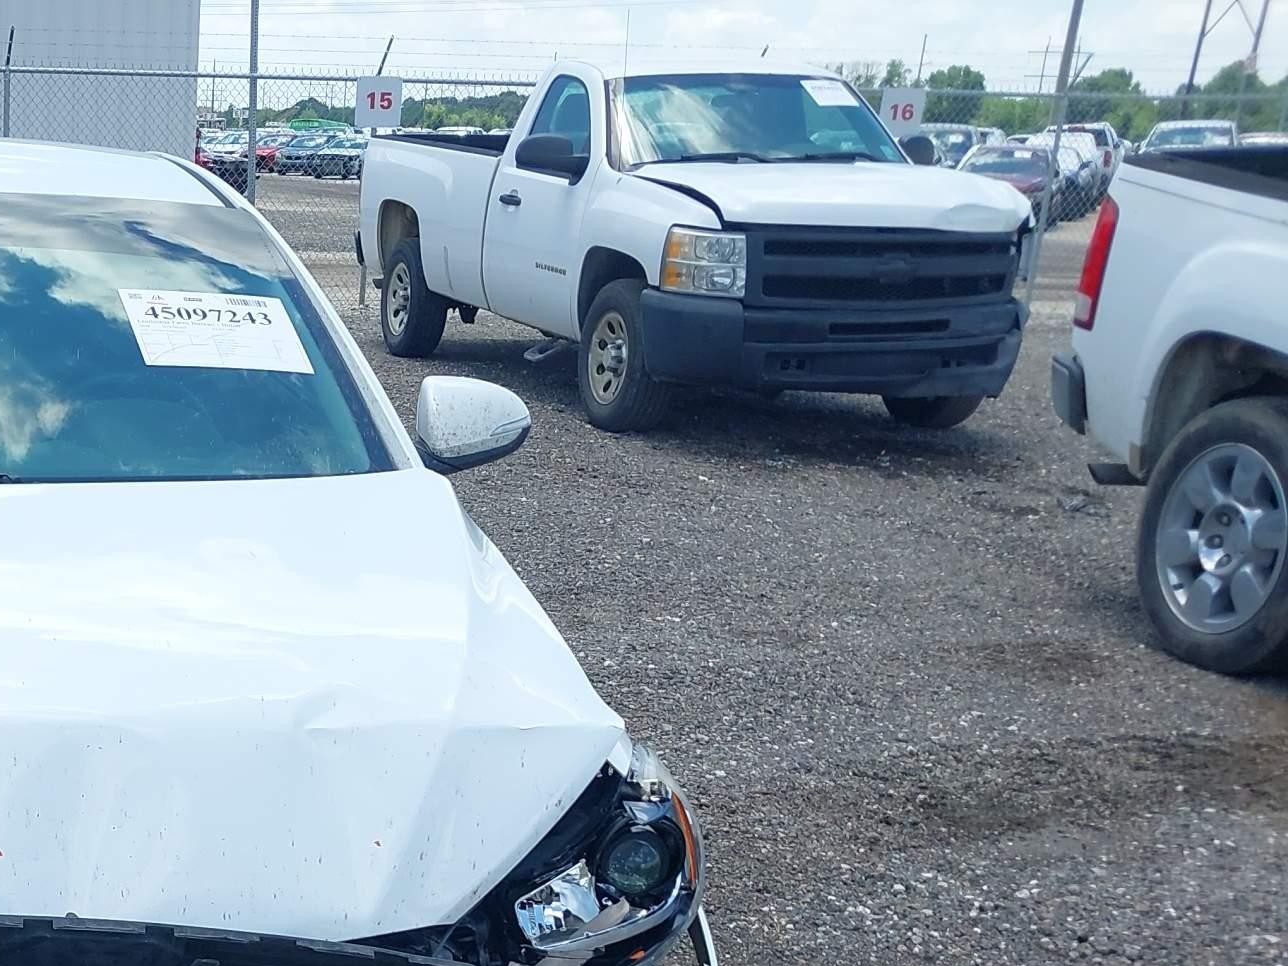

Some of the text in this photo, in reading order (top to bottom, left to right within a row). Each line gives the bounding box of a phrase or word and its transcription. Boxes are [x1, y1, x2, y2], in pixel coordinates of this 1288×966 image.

[367, 91, 393, 110] 15
[890, 103, 915, 121] 16
[144, 306, 272, 326] 45097243
